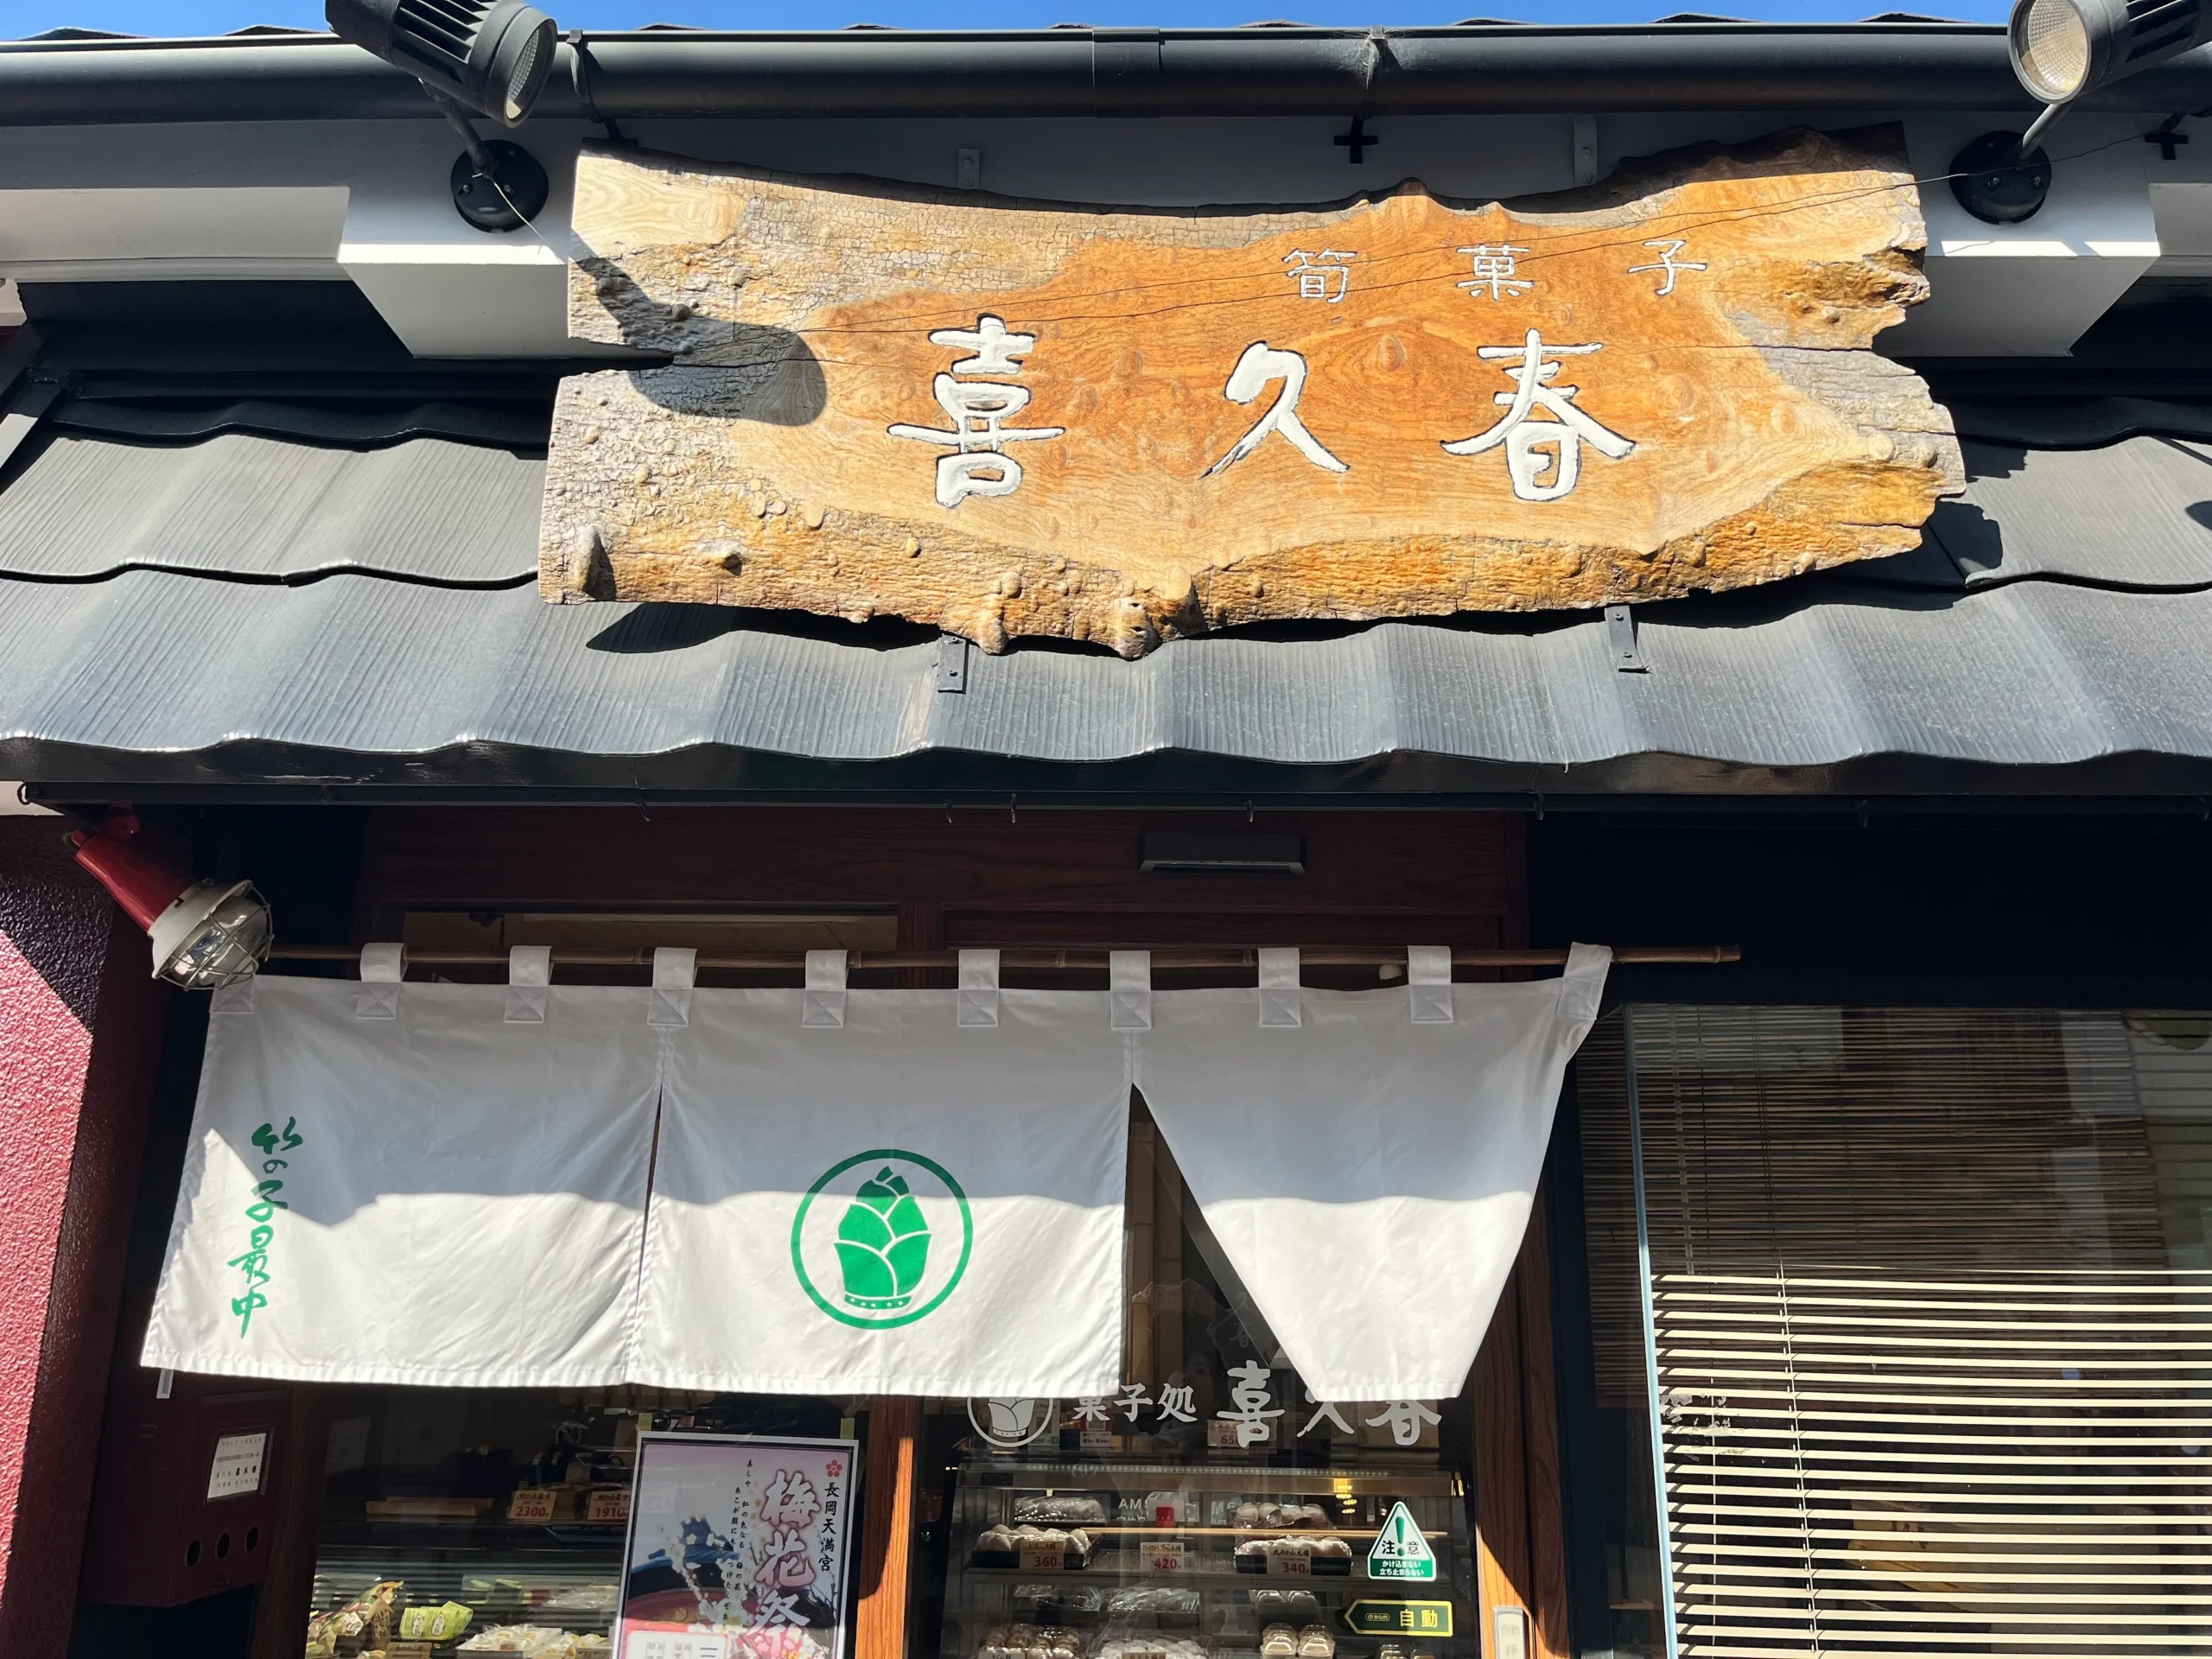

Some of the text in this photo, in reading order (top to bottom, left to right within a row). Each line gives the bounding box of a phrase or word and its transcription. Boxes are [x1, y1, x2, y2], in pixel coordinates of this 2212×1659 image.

[1284, 238, 1707, 303] 筍菓子
[887, 314, 1635, 506] 喜久春
[746, 1471, 820, 1652] 梅花祭
[818, 1482, 840, 1572] 長岡天満宮
[1382, 1560, 1421, 1568] かけ込まない
[1400, 1609, 1438, 1628] 自動
